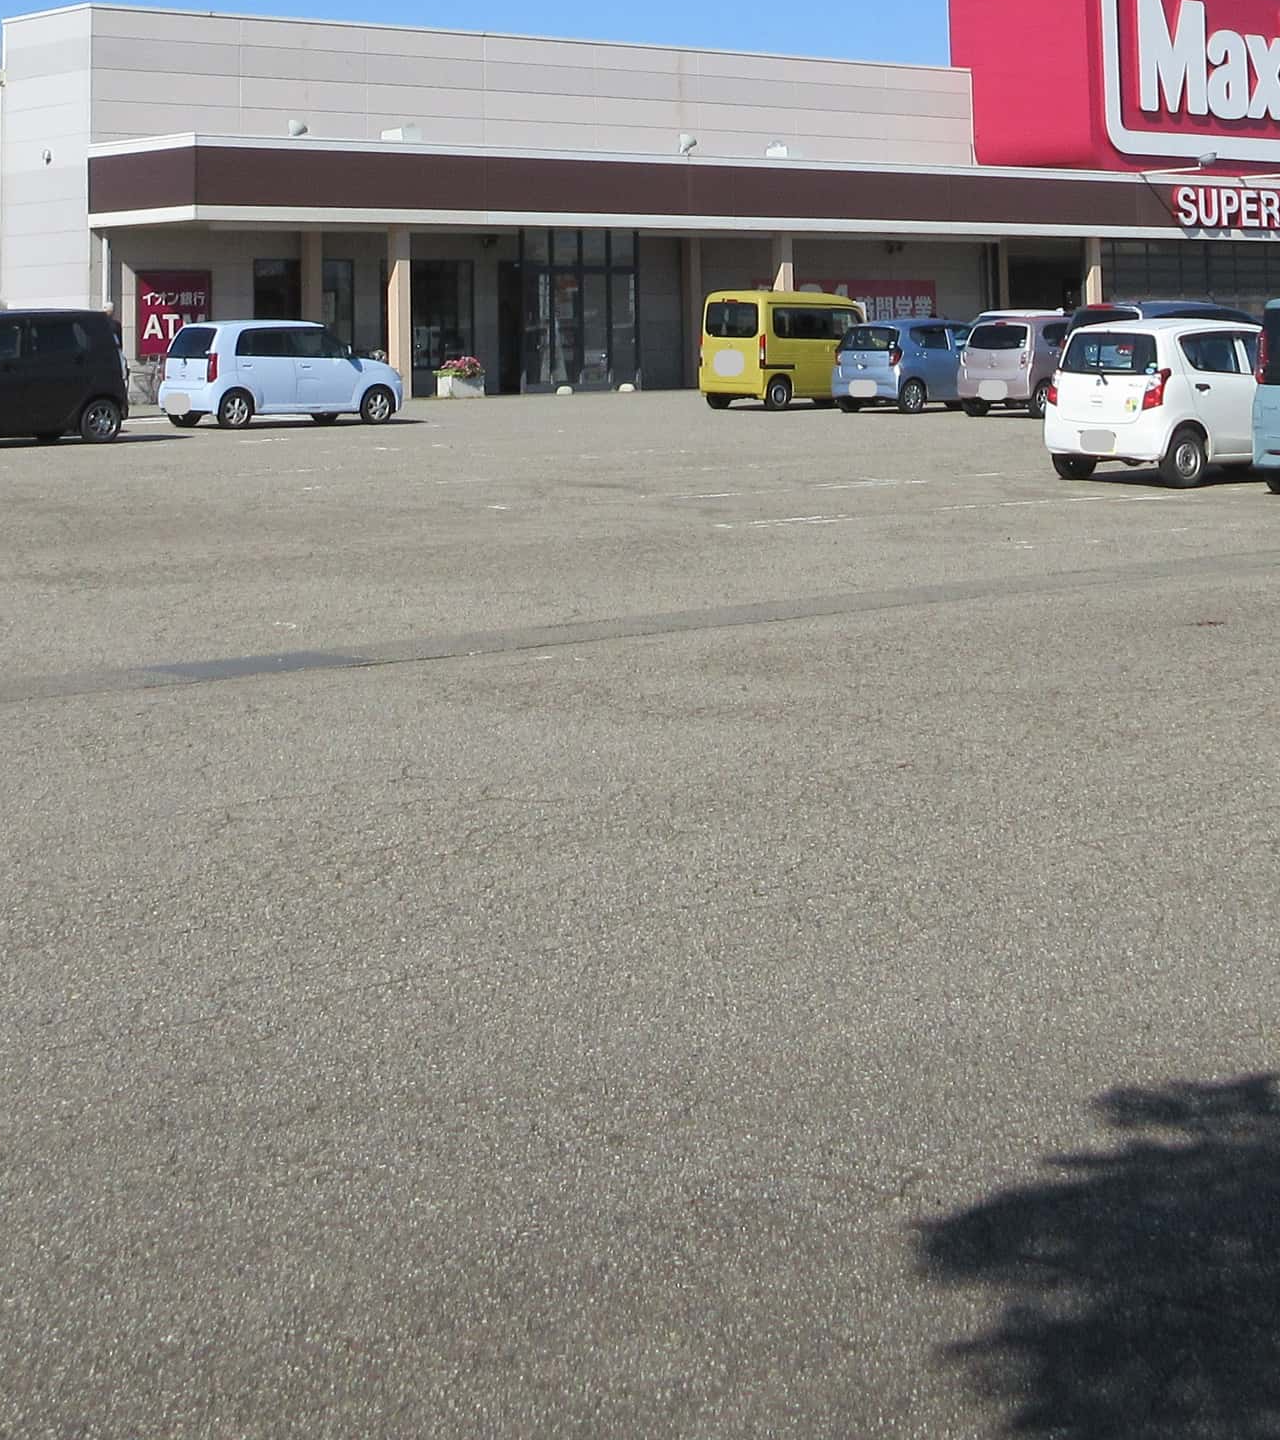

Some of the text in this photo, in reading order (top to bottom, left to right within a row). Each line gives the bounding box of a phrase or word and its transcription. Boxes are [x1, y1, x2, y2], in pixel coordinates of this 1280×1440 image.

[142, 291, 206, 306] イオン銀行
